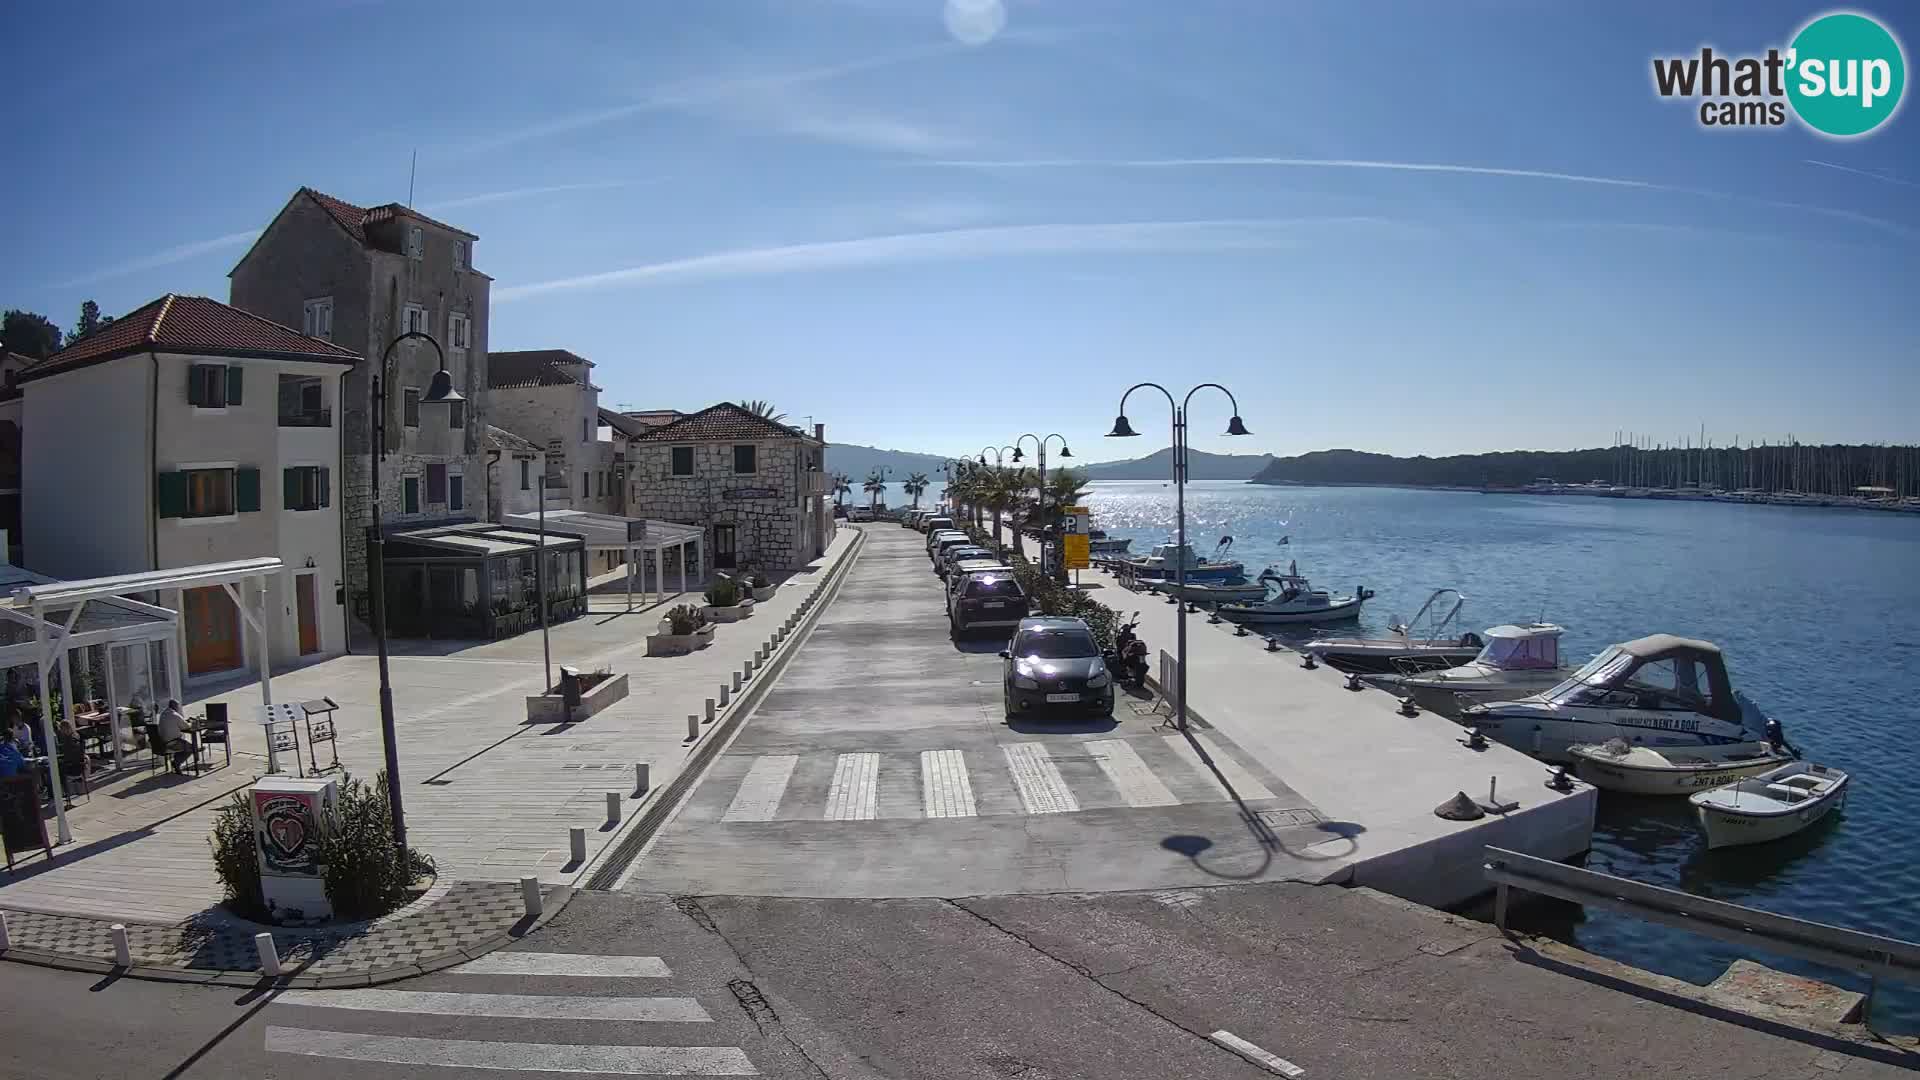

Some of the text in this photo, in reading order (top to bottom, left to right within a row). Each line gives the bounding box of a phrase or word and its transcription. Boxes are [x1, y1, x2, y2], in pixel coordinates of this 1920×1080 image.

[1065, 516, 1076, 532] P
[1652, 718, 1673, 730] RENT
[1674, 719, 1680, 730] A
[1681, 719, 1700, 732] BOAT
